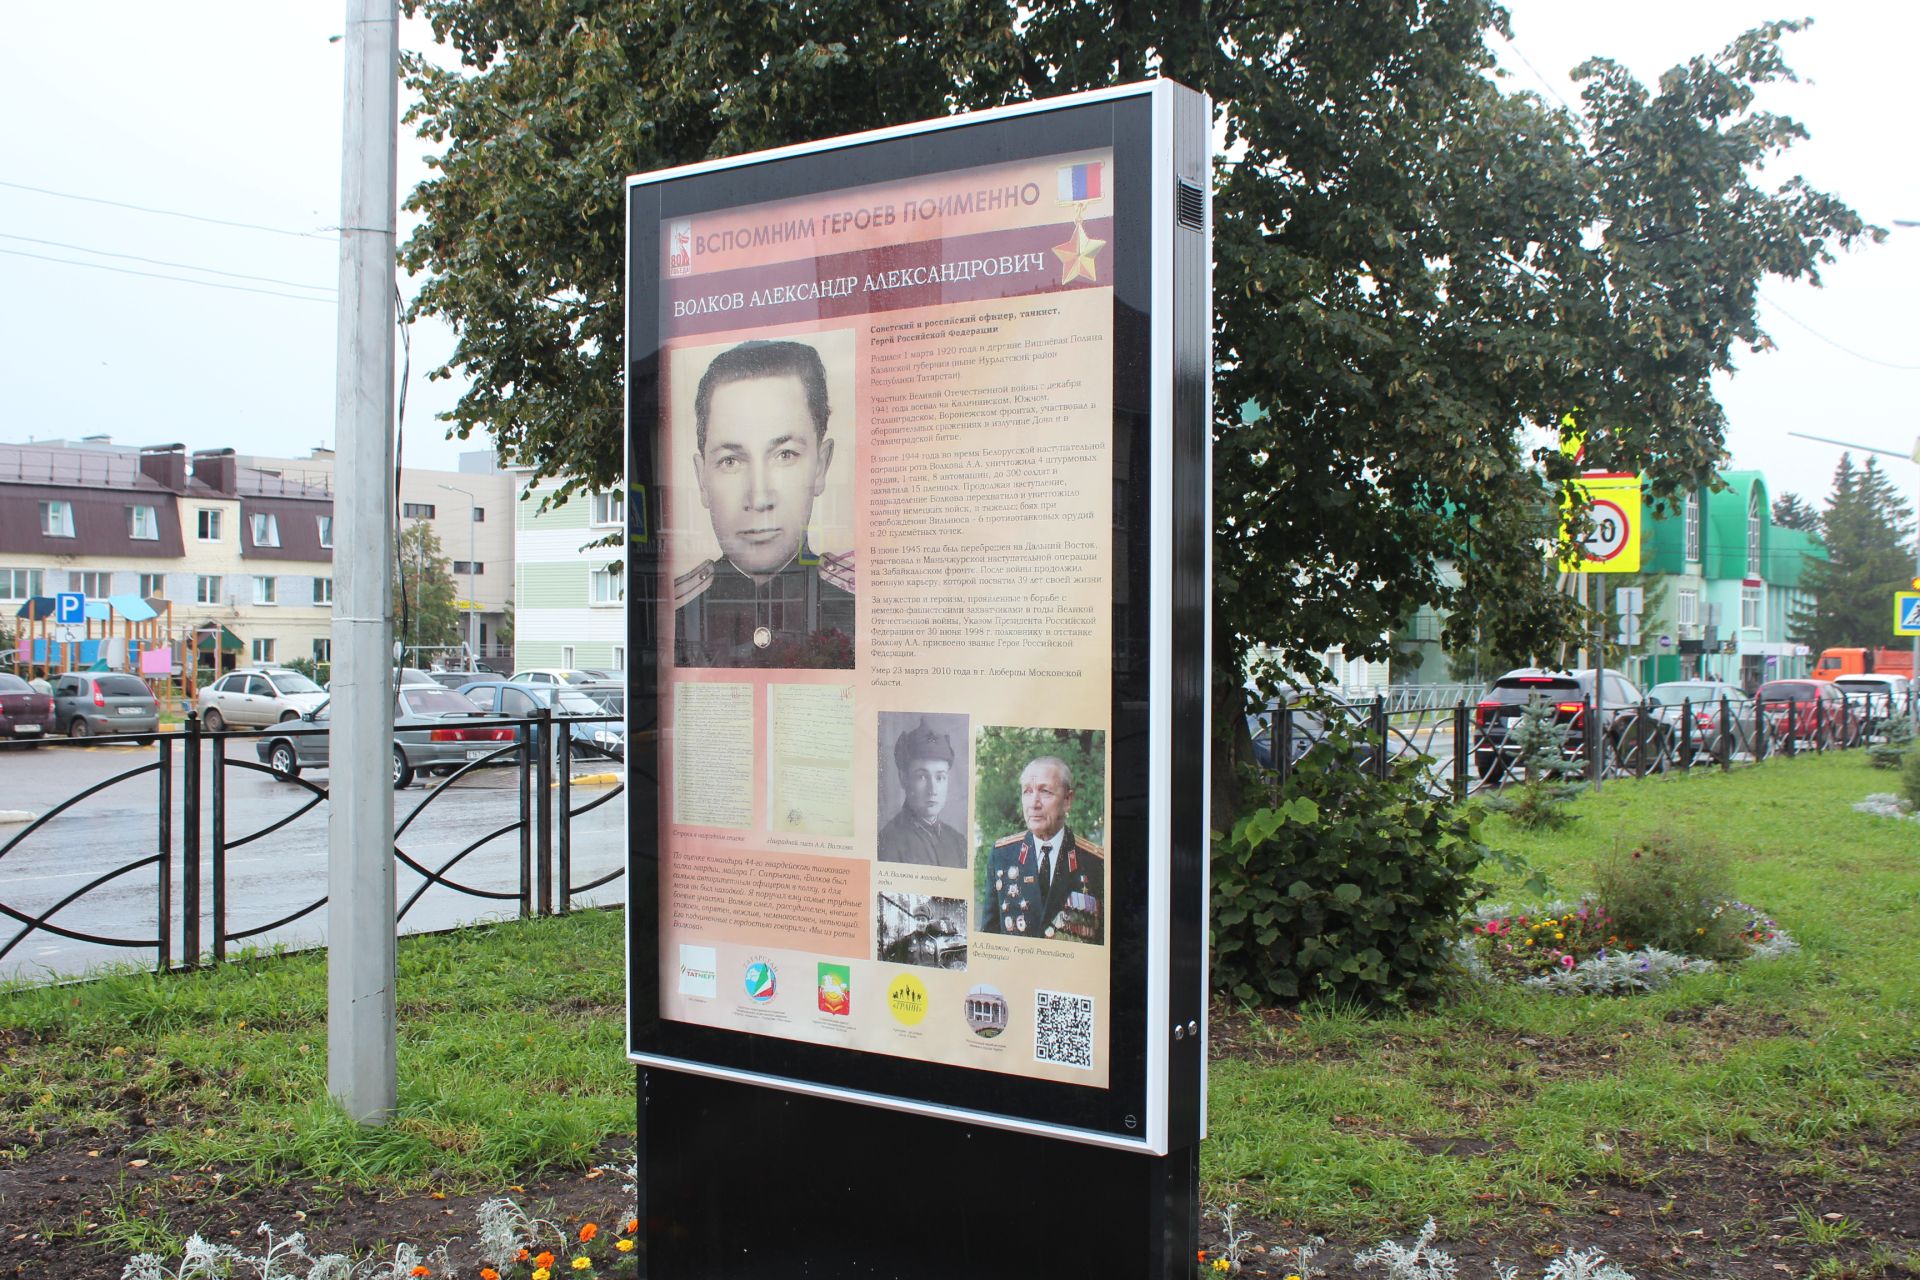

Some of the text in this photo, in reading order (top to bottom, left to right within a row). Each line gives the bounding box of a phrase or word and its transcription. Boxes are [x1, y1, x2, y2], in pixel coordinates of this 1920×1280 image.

[695, 182, 1039, 256] ВСПОМНИМ ГЕРОЕВ ПОИМЕННО
[674, 252, 1043, 318] ВОЛКОВ АЛЕКСАНДР АЛЕКСАНДРОВИЧ
[870, 321, 914, 333] Советский
[924, 314, 976, 329] российский
[870, 324, 998, 346] Герой Российской Федерации
[937, 346, 956, 356] 1920
[902, 544, 922, 552] 1945
